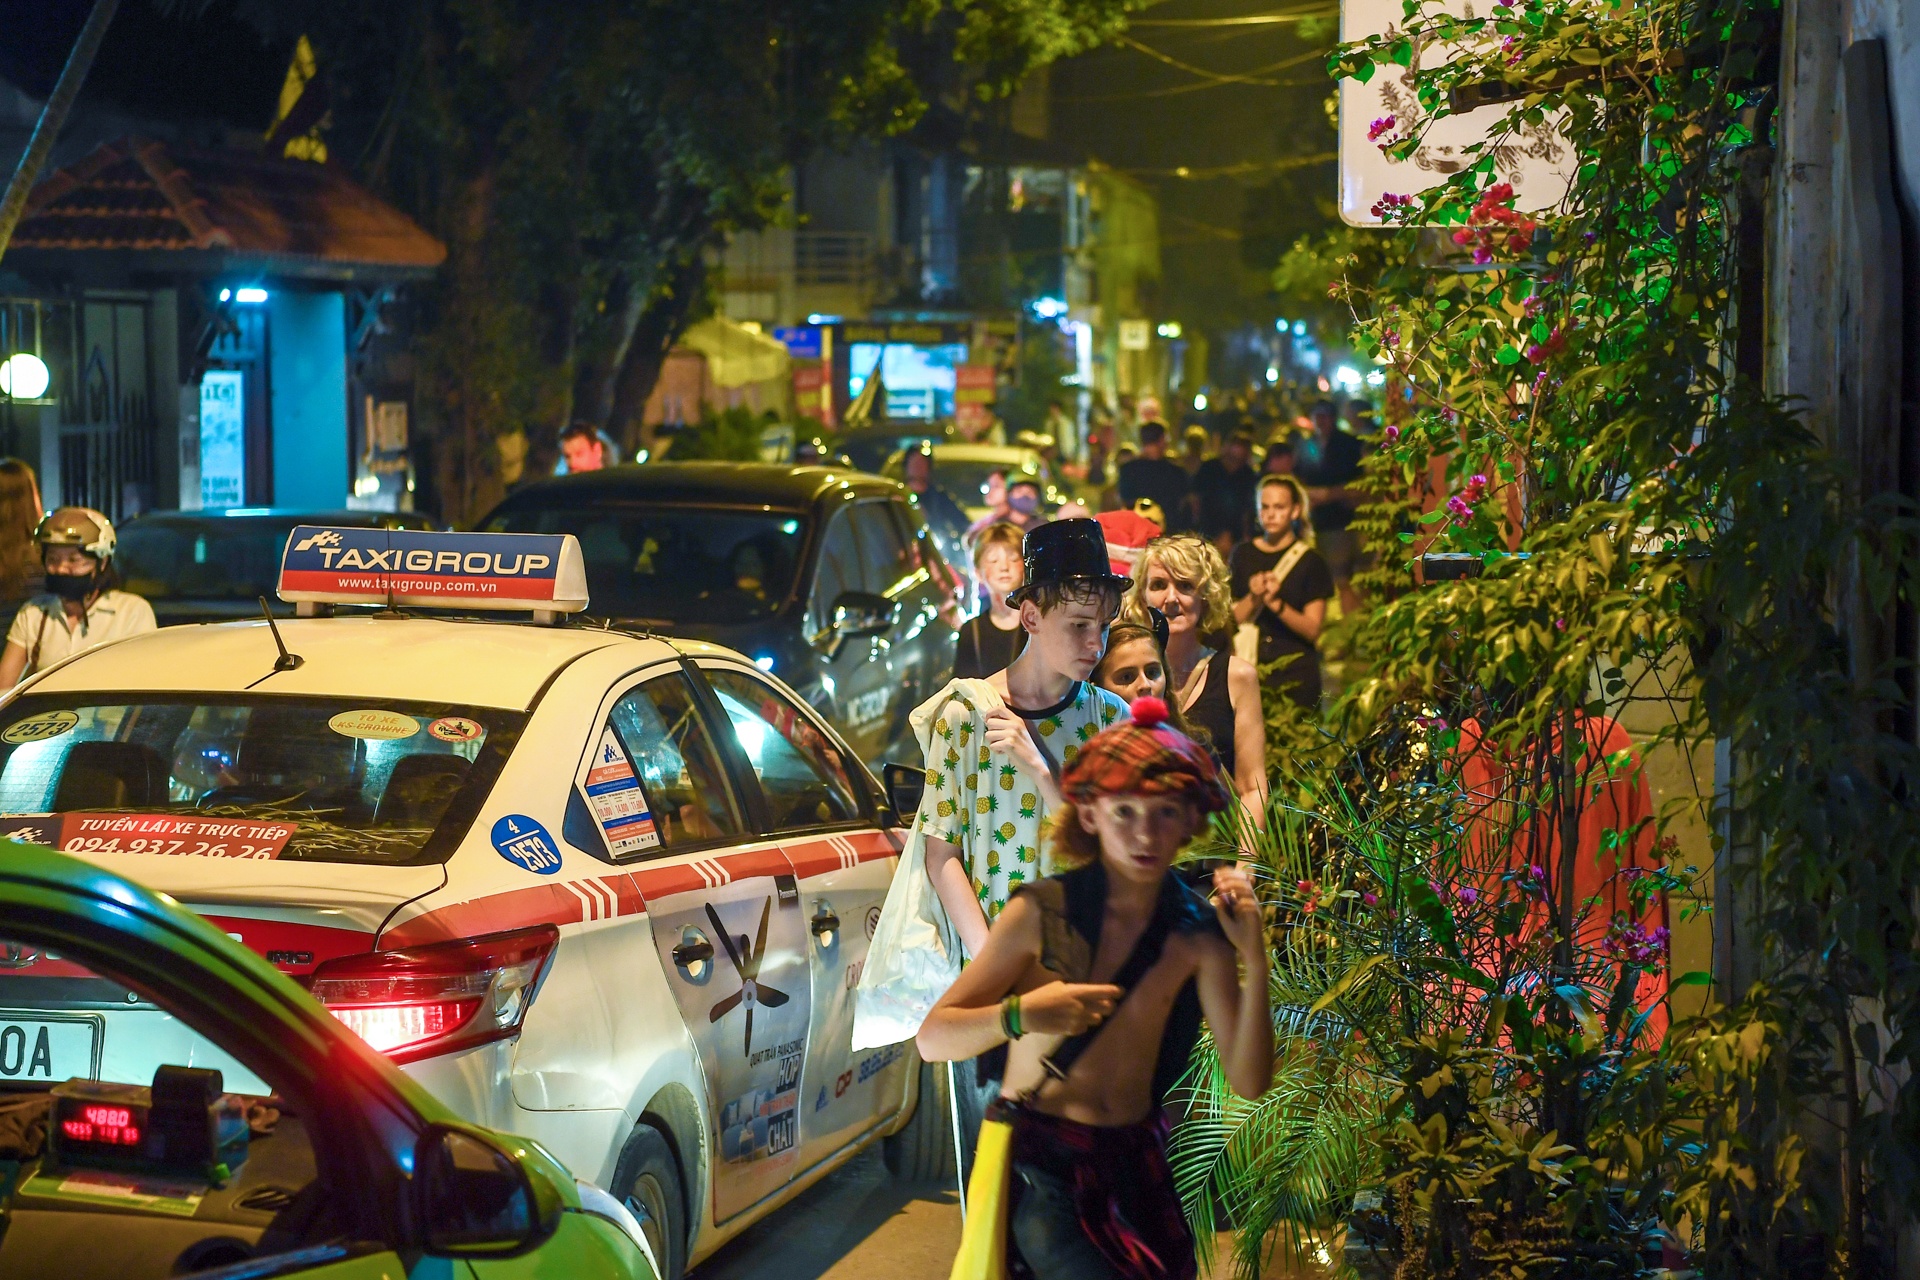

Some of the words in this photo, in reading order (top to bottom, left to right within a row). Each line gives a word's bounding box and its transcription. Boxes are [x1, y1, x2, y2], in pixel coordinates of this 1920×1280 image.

[319, 547, 550, 575] TAXIGROUP
[338, 576, 497, 593] www.taxigroup.com.vn
[380, 716, 400, 724] XE
[6, 722, 70, 736] 2573
[80, 816, 139, 831] TUYỂN
[139, 819, 171, 833] LÁI
[170, 822, 196, 835] XE
[197, 823, 247, 840] TRỰC
[247, 825, 288, 841] TIẾP
[508, 819, 520, 834] 4
[508, 836, 559, 871] 2573
